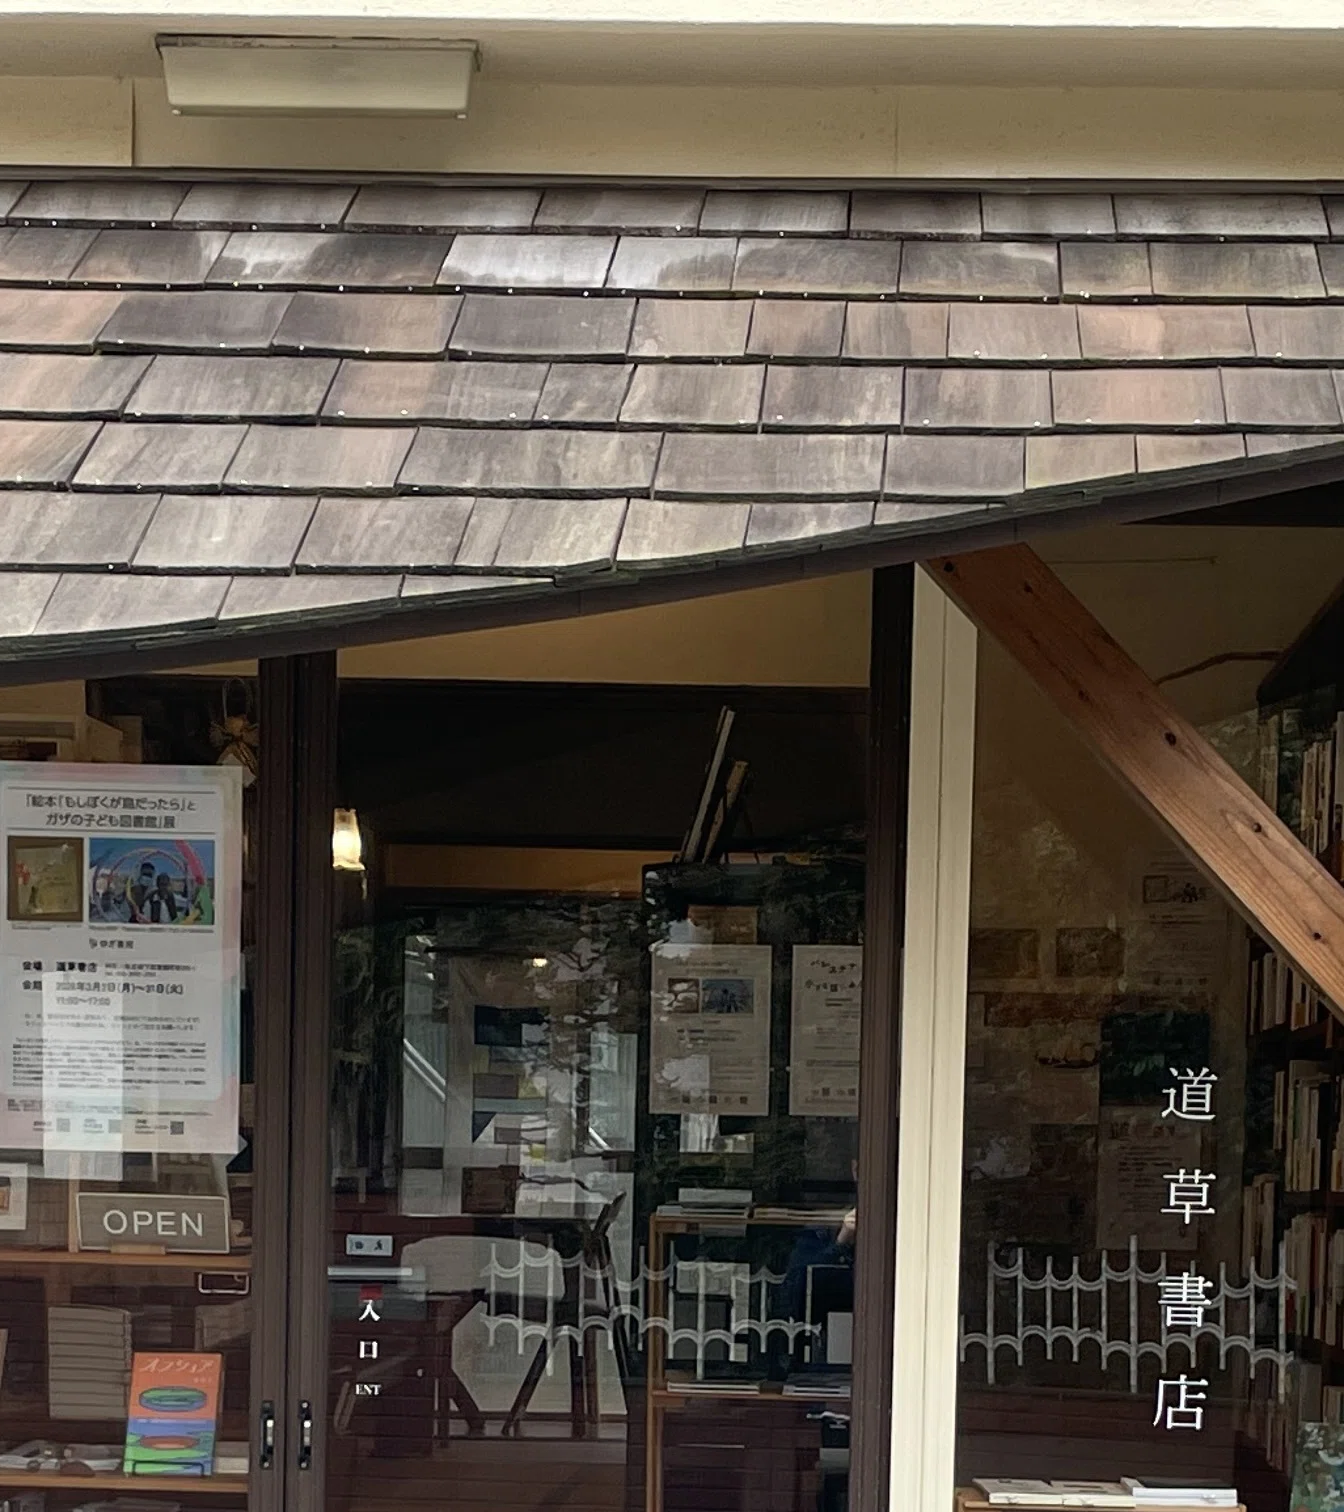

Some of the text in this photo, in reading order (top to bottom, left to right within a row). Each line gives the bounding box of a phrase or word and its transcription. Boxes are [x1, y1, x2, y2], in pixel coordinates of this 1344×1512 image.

[102, 1208, 205, 1239] OPEN
[1152, 1066, 1219, 1431] 道草書店
[358, 1299, 382, 1360] 入口
[355, 1383, 382, 1397] ENT
